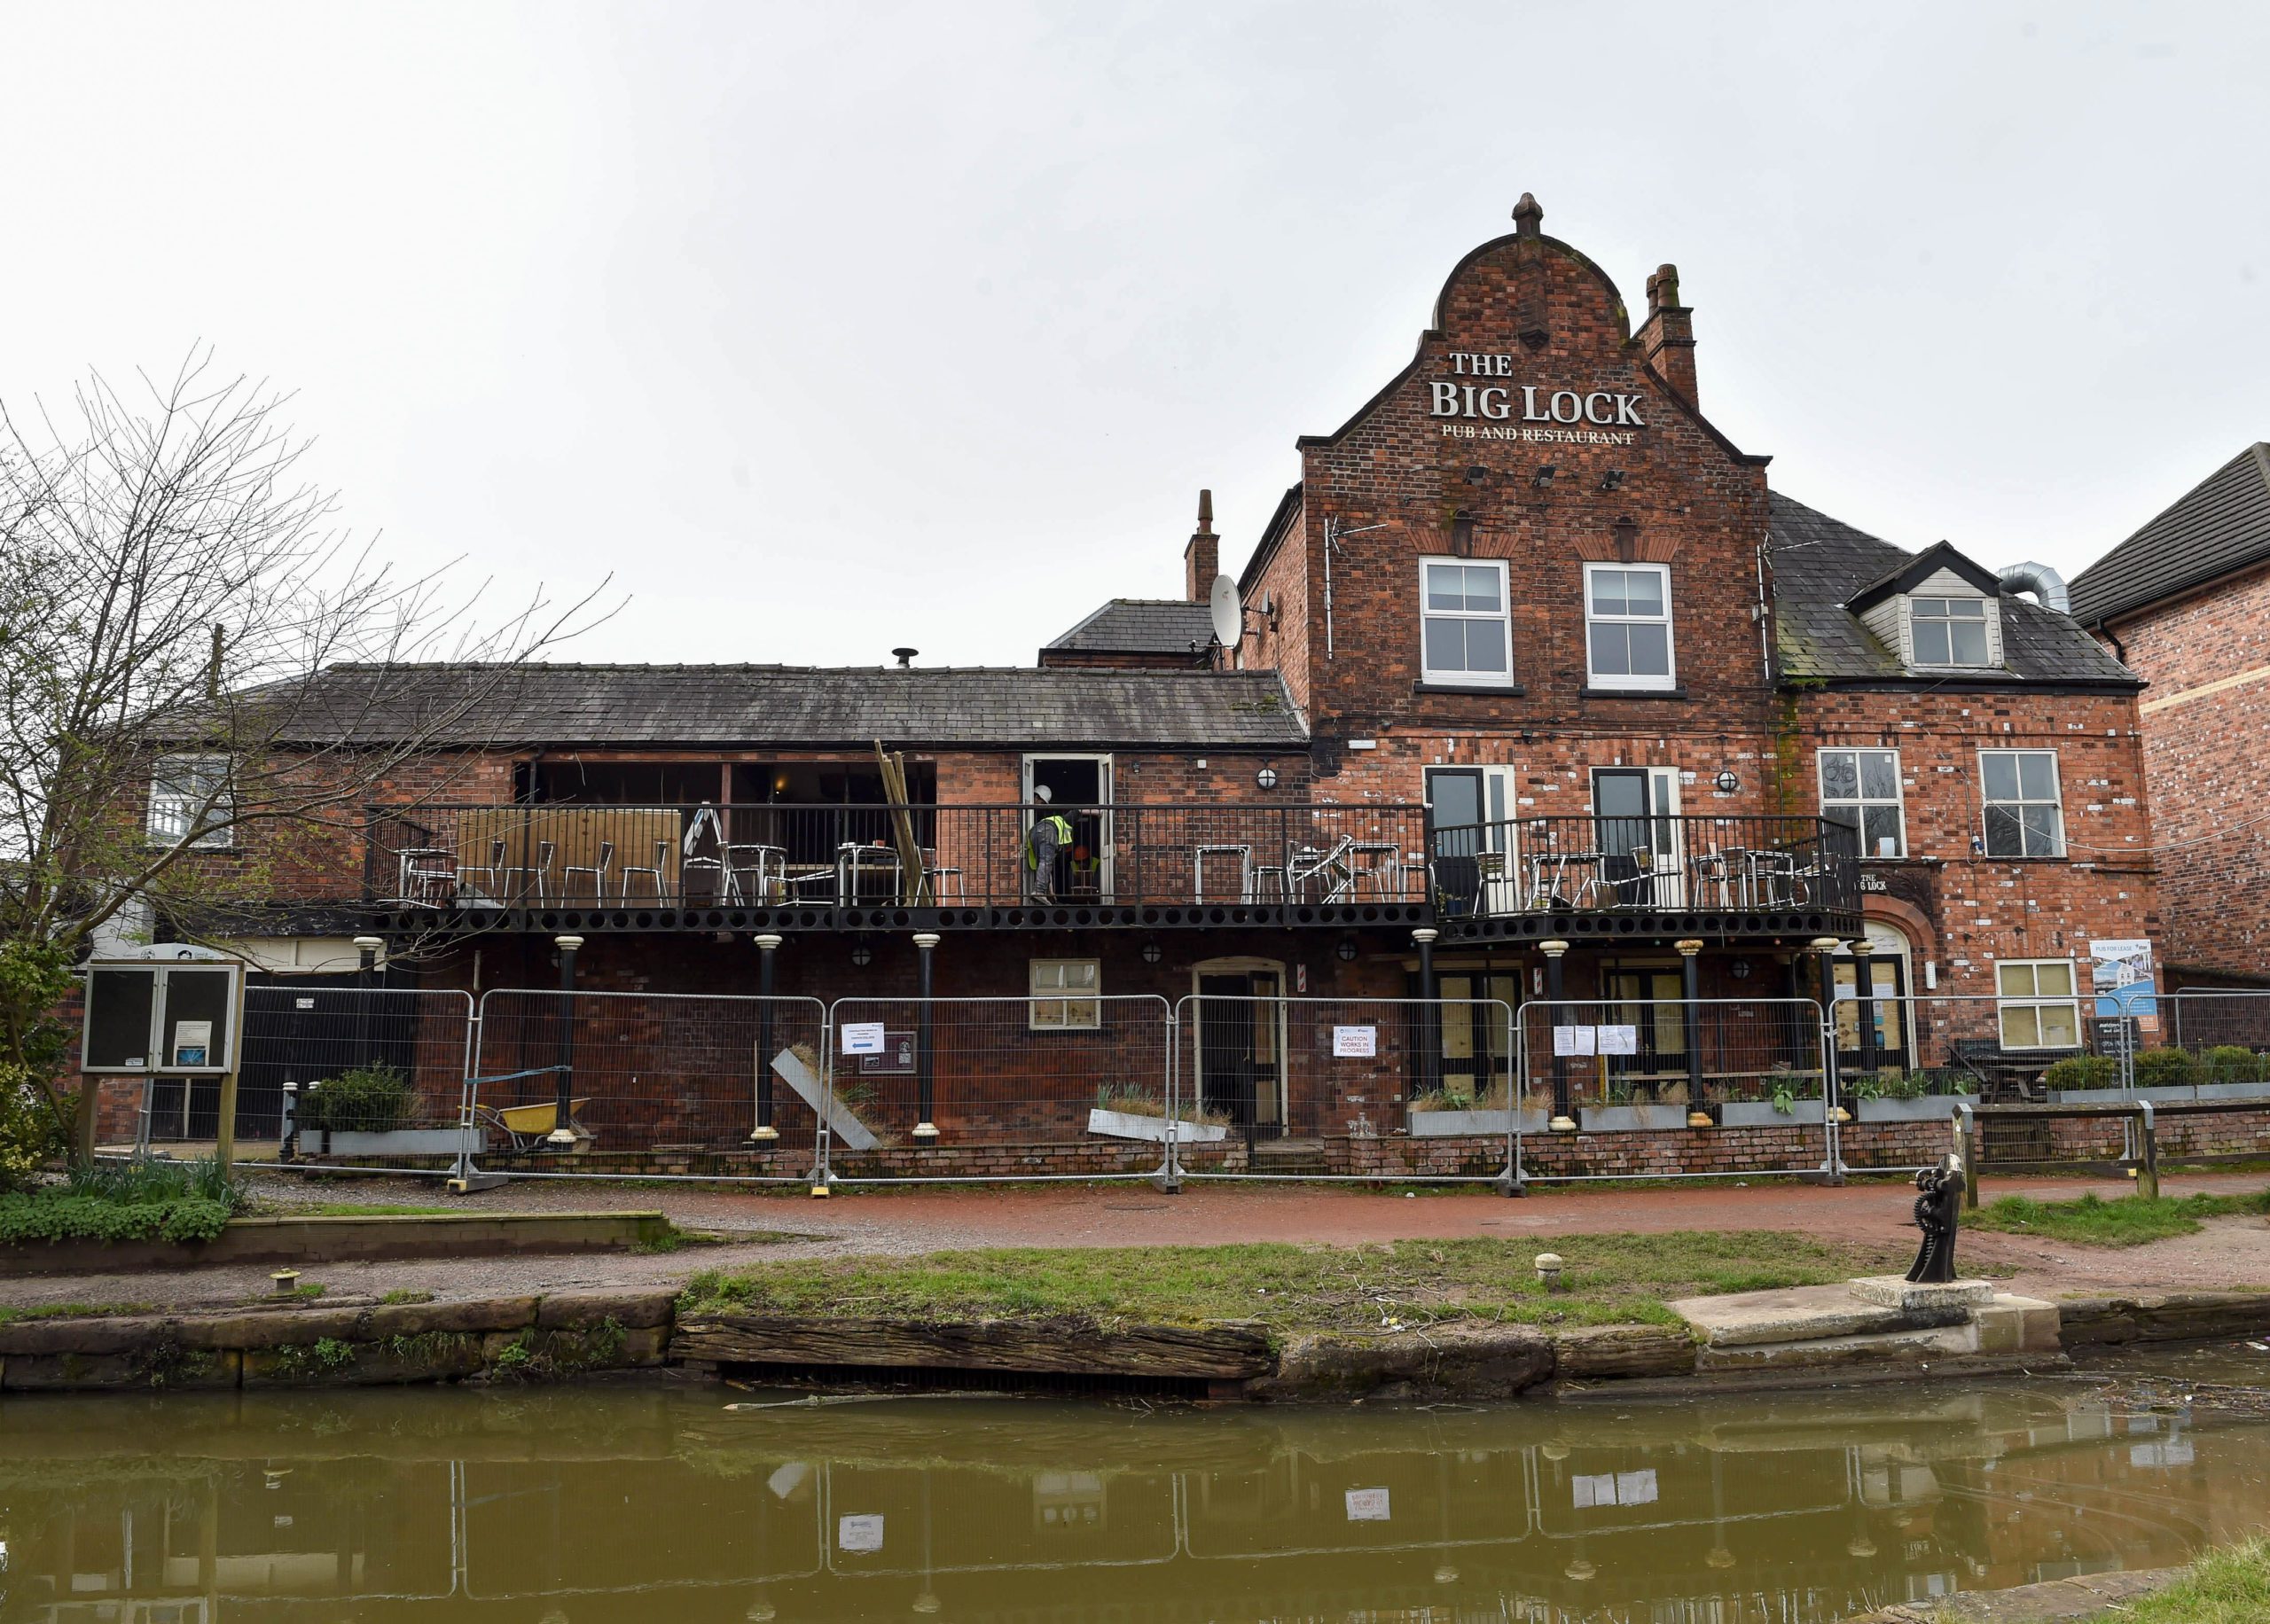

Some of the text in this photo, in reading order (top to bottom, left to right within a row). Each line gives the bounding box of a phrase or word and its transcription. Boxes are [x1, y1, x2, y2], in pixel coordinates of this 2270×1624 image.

[1449, 352, 1513, 377] THE
[1429, 381, 1646, 426] BIG LOCK
[1442, 425, 1634, 445] PUB AND RESTAURANT
[1867, 881, 1887, 890] LOCK
